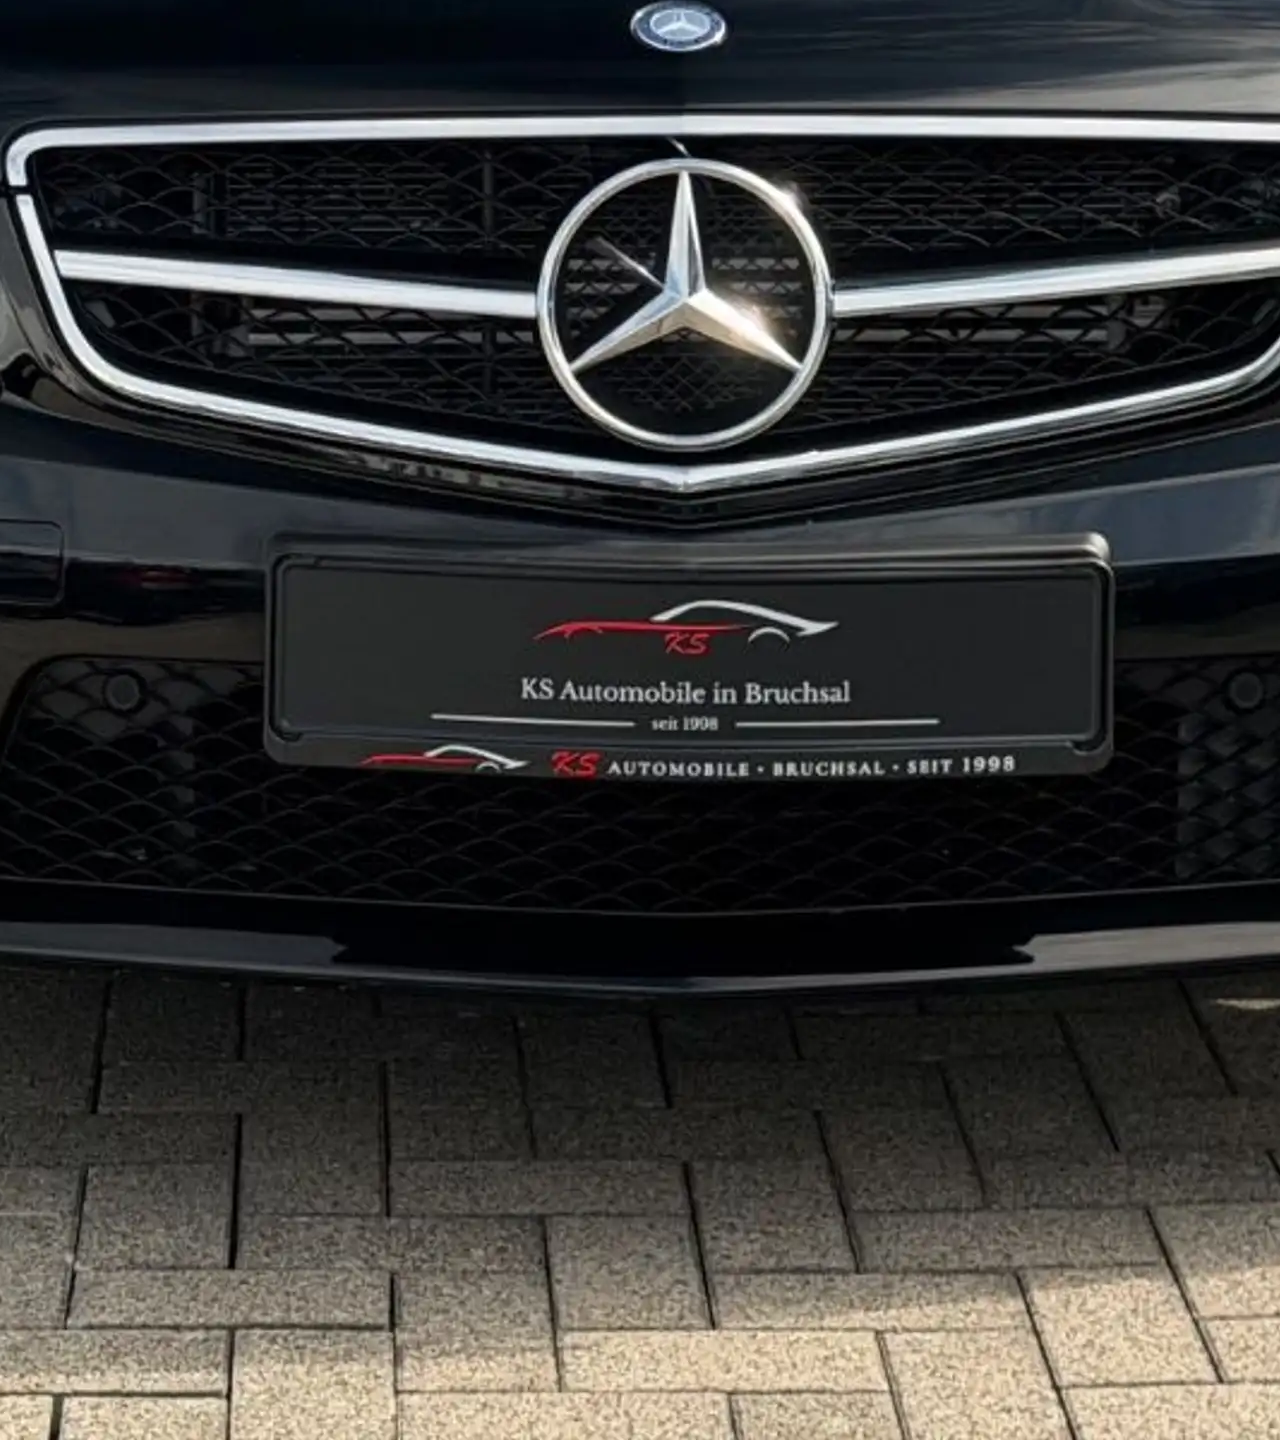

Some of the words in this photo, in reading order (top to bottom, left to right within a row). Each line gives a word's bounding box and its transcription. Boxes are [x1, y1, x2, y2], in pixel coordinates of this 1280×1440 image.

[664, 631, 710, 655] KS
[521, 676, 555, 700] KS
[560, 679, 706, 704] Automobile
[713, 681, 737, 704] in
[745, 680, 851, 705] Bruchsal
[651, 715, 679, 731] seit
[551, 751, 601, 777] KS
[607, 761, 749, 777] AUTOMOBILE
[773, 761, 886, 777] BRUCHSAL
[907, 759, 952, 775] SEIT
[962, 755, 1016, 773] 1998
